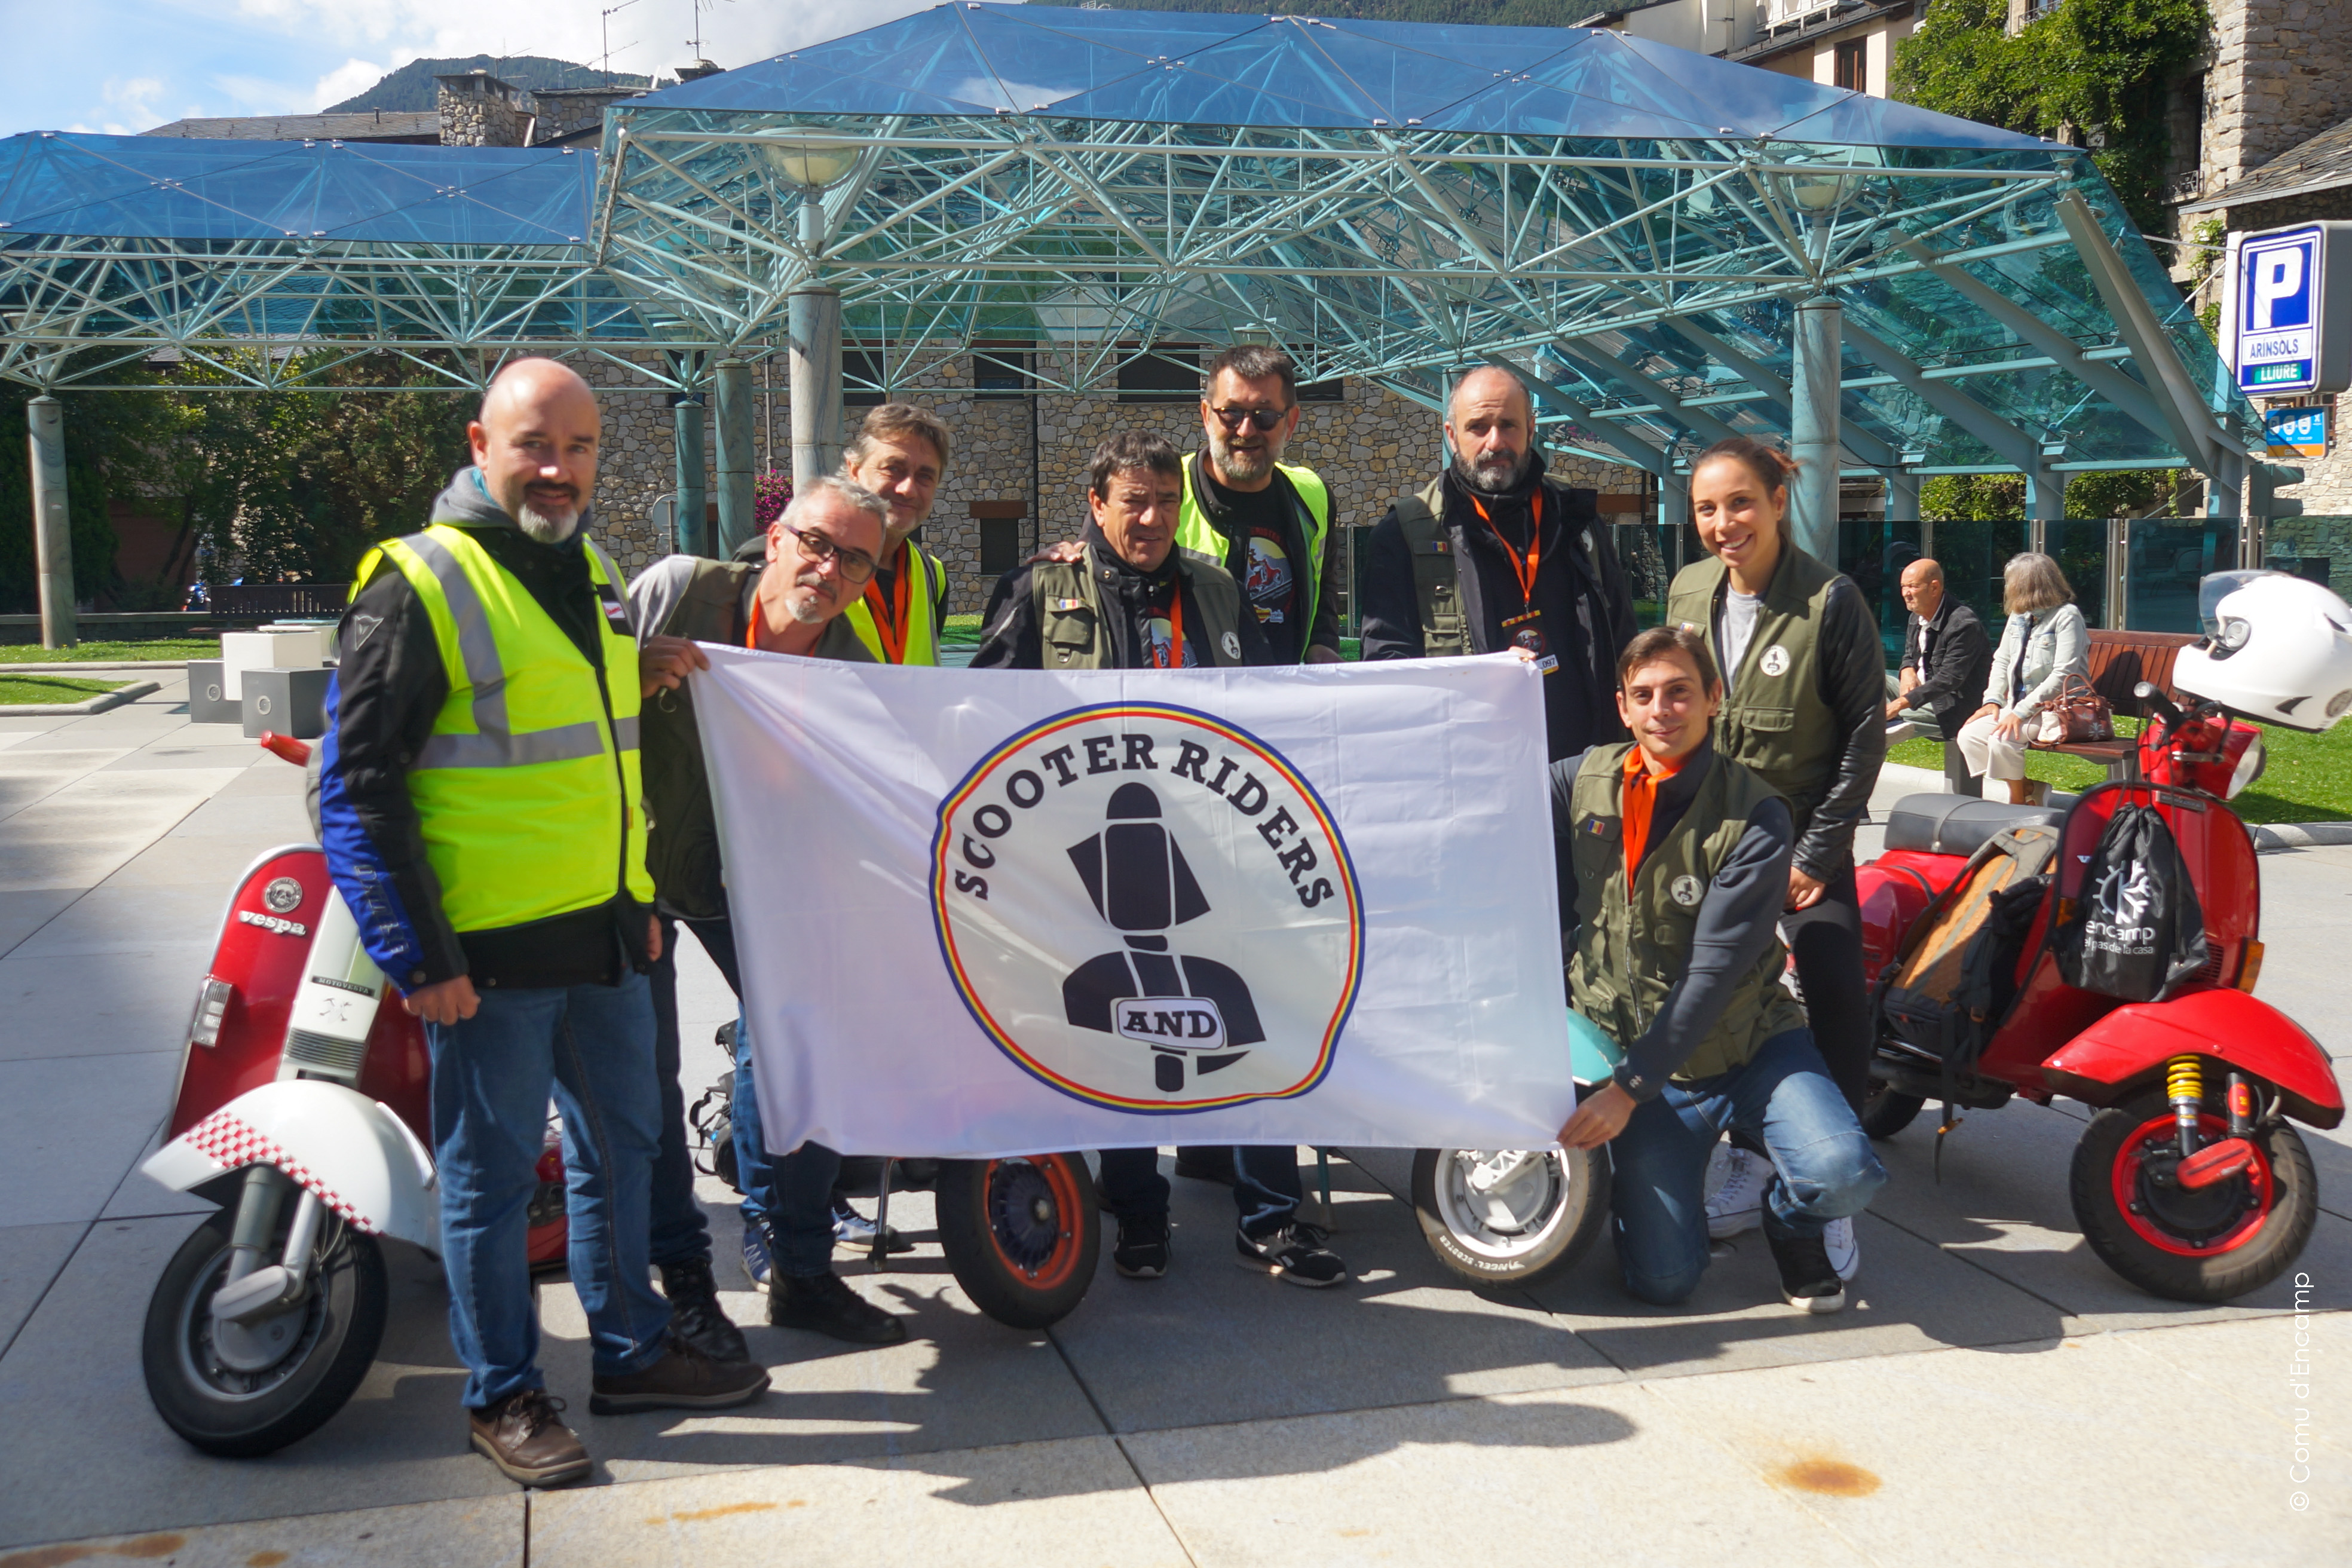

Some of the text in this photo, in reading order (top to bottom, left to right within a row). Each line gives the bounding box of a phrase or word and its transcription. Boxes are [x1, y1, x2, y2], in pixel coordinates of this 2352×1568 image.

[2253, 247, 2302, 329] P
[2261, 364, 2298, 381] LLIURE
[1542, 658, 1555, 668] 097
[955, 733, 1334, 908] SCOOTER RIDERS
[239, 910, 307, 936] vespa
[2085, 920, 2155, 945] encamp
[2091, 941, 2108, 951] pas
[2109, 942, 2122, 954] de
[2123, 944, 2131, 954] la
[2133, 946, 2154, 954] casa
[318, 977, 369, 994] MOTOVESPA
[1123, 1010, 1218, 1039] AND
[1440, 1235, 1474, 1264] SCOOTER
